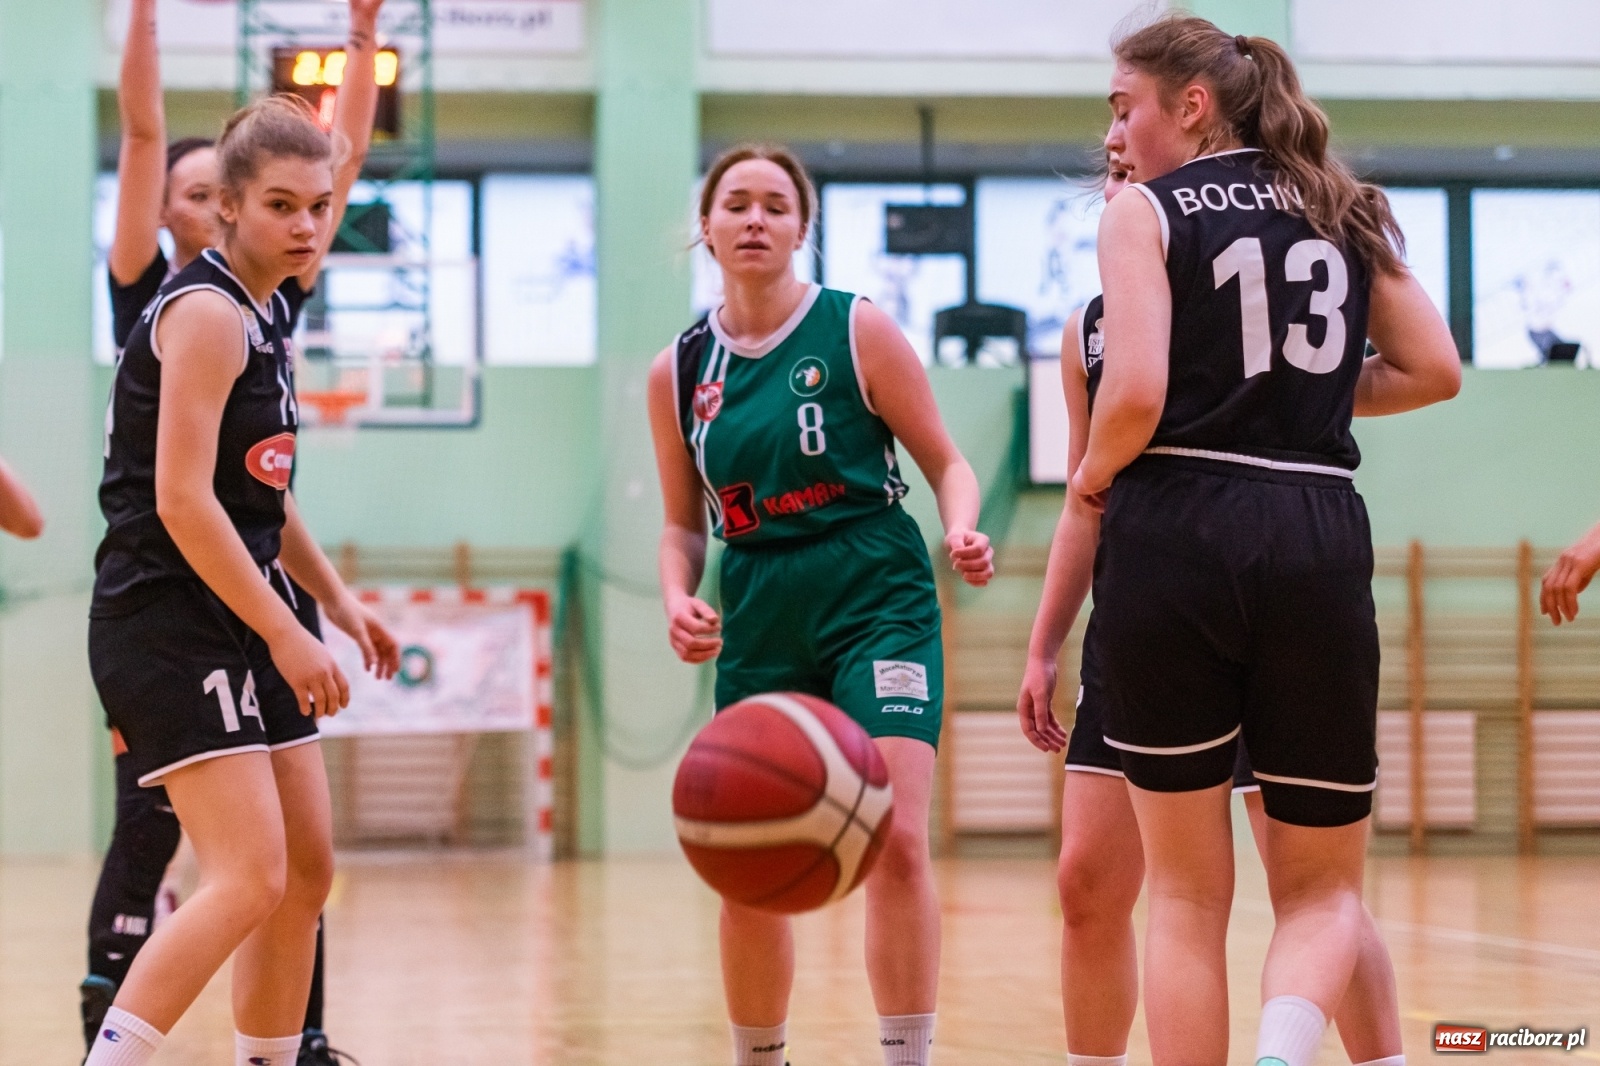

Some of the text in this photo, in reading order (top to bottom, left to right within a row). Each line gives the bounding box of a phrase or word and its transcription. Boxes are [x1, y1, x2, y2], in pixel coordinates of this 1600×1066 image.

[1172, 183, 1317, 217] BOCHN
[1212, 236, 1349, 379] 13
[797, 402, 826, 456] 8
[763, 482, 845, 515] KAMAN
[202, 669, 266, 733] 14
[881, 704, 924, 715] COLO
